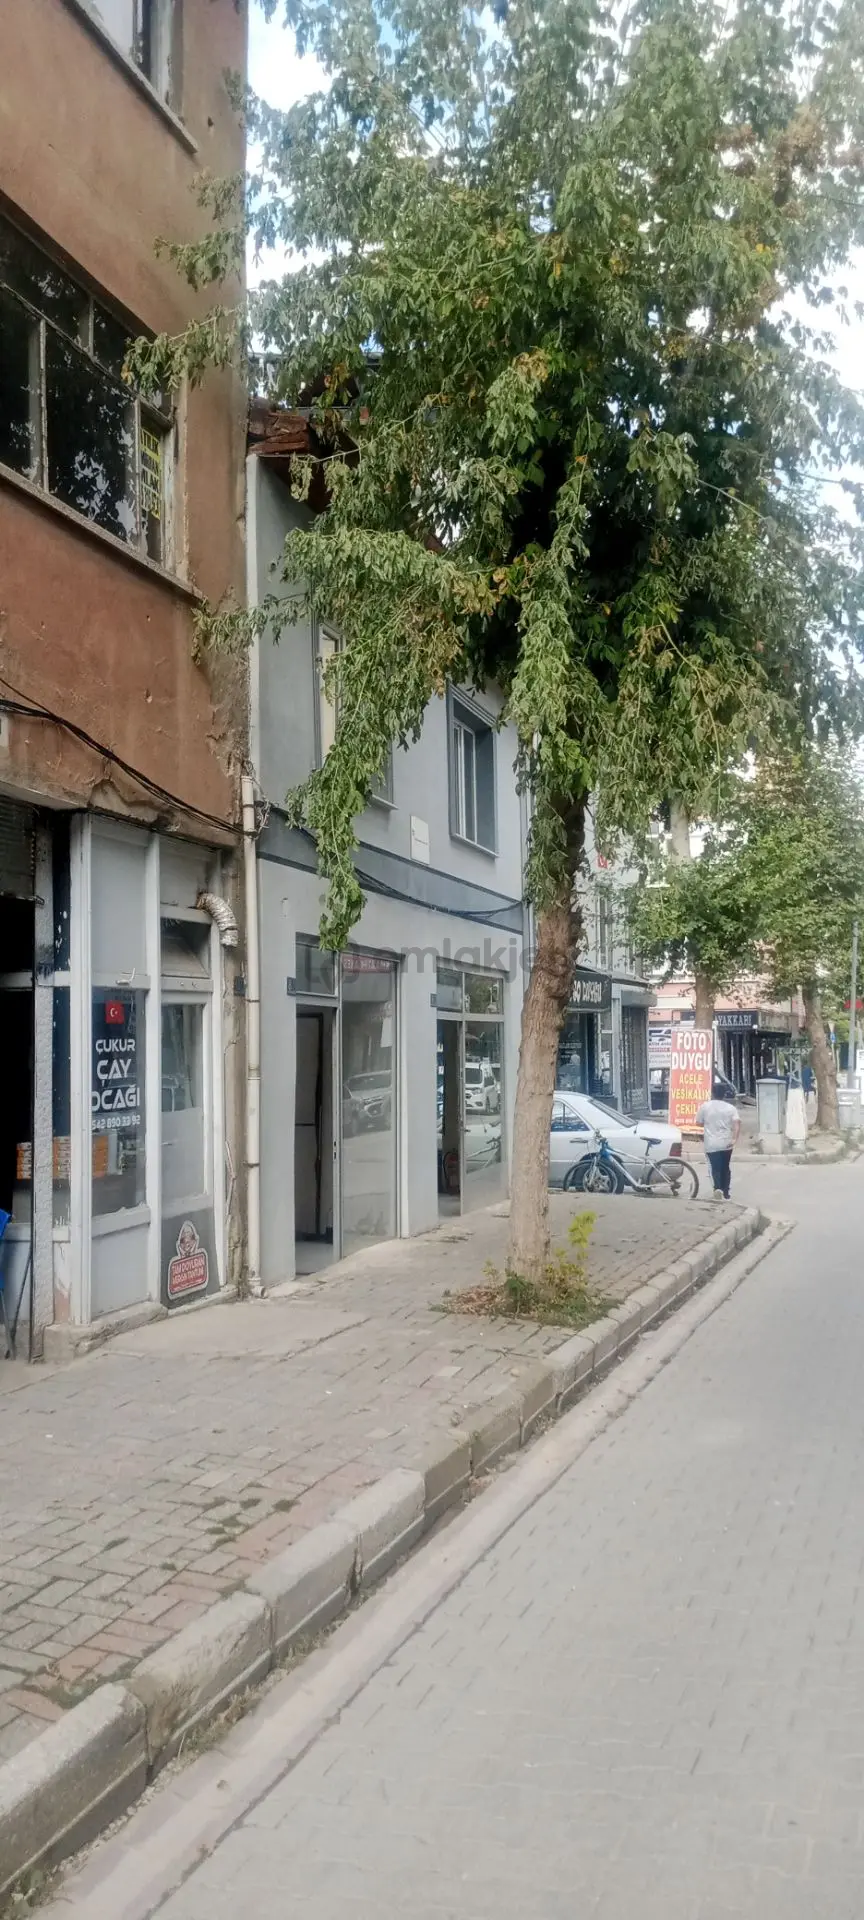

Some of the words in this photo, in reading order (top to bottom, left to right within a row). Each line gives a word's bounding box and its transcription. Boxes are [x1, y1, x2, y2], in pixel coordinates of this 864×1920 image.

[95, 1038, 136, 1055] ÇUKUR
[676, 1032, 706, 1050] FOTO
[672, 1052, 711, 1070] DUYGU
[96, 1058, 132, 1087] ÇAY
[679, 1073, 704, 1085] ACELE
[91, 1083, 141, 1112] OCAĞI
[675, 1101, 699, 1117] ÇEKİL
